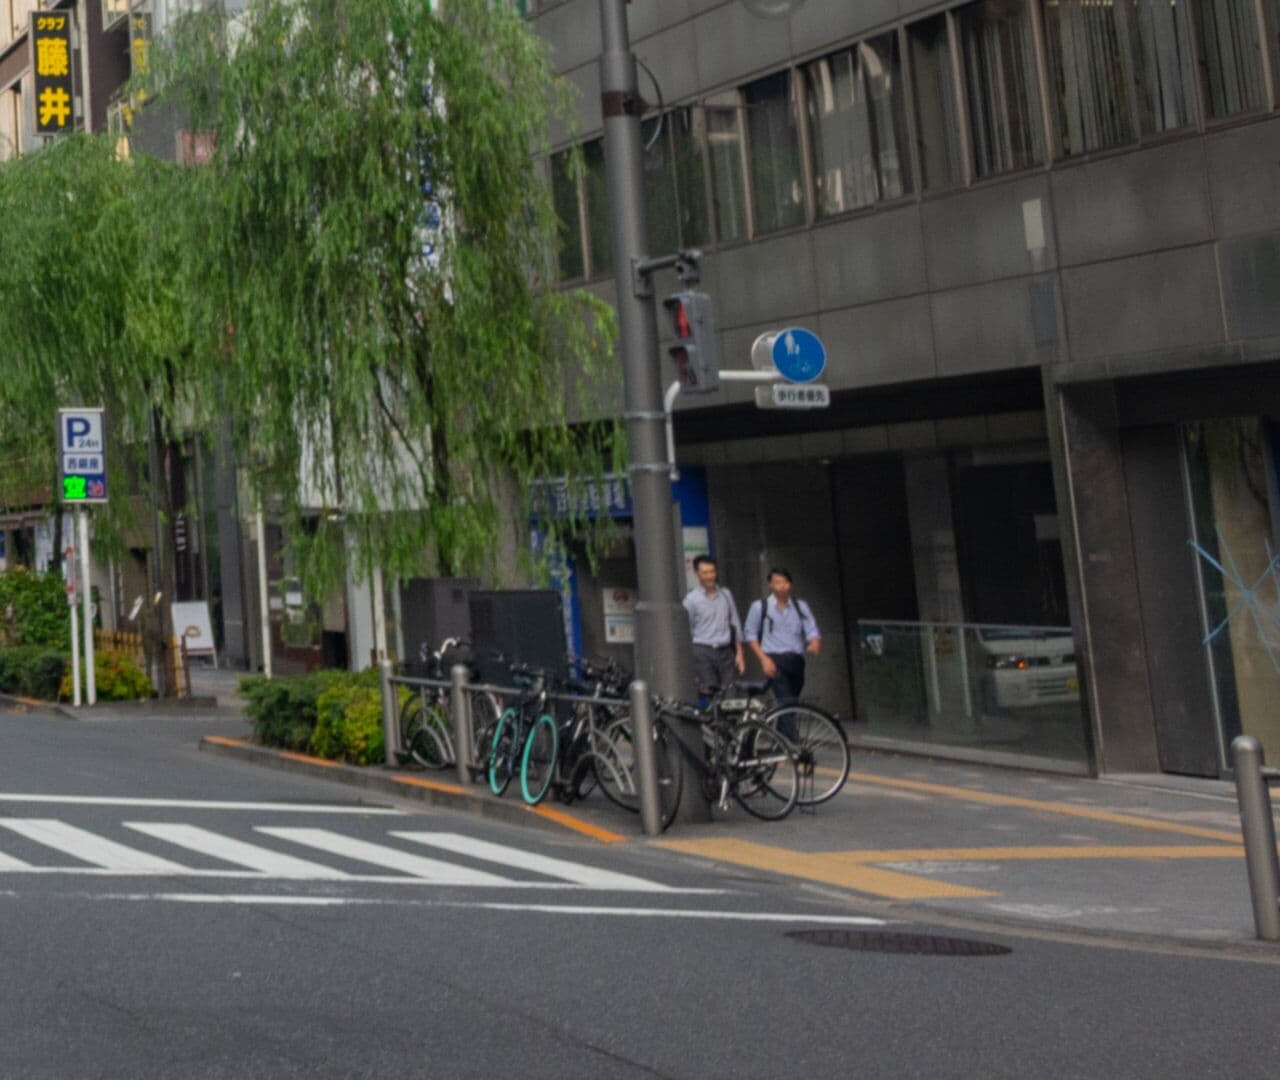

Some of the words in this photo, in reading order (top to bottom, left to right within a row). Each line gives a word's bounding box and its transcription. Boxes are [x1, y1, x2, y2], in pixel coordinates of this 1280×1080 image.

[37, 18, 65, 30] クラブ
[37, 38, 71, 127] 藤井
[66, 417, 91, 448] P
